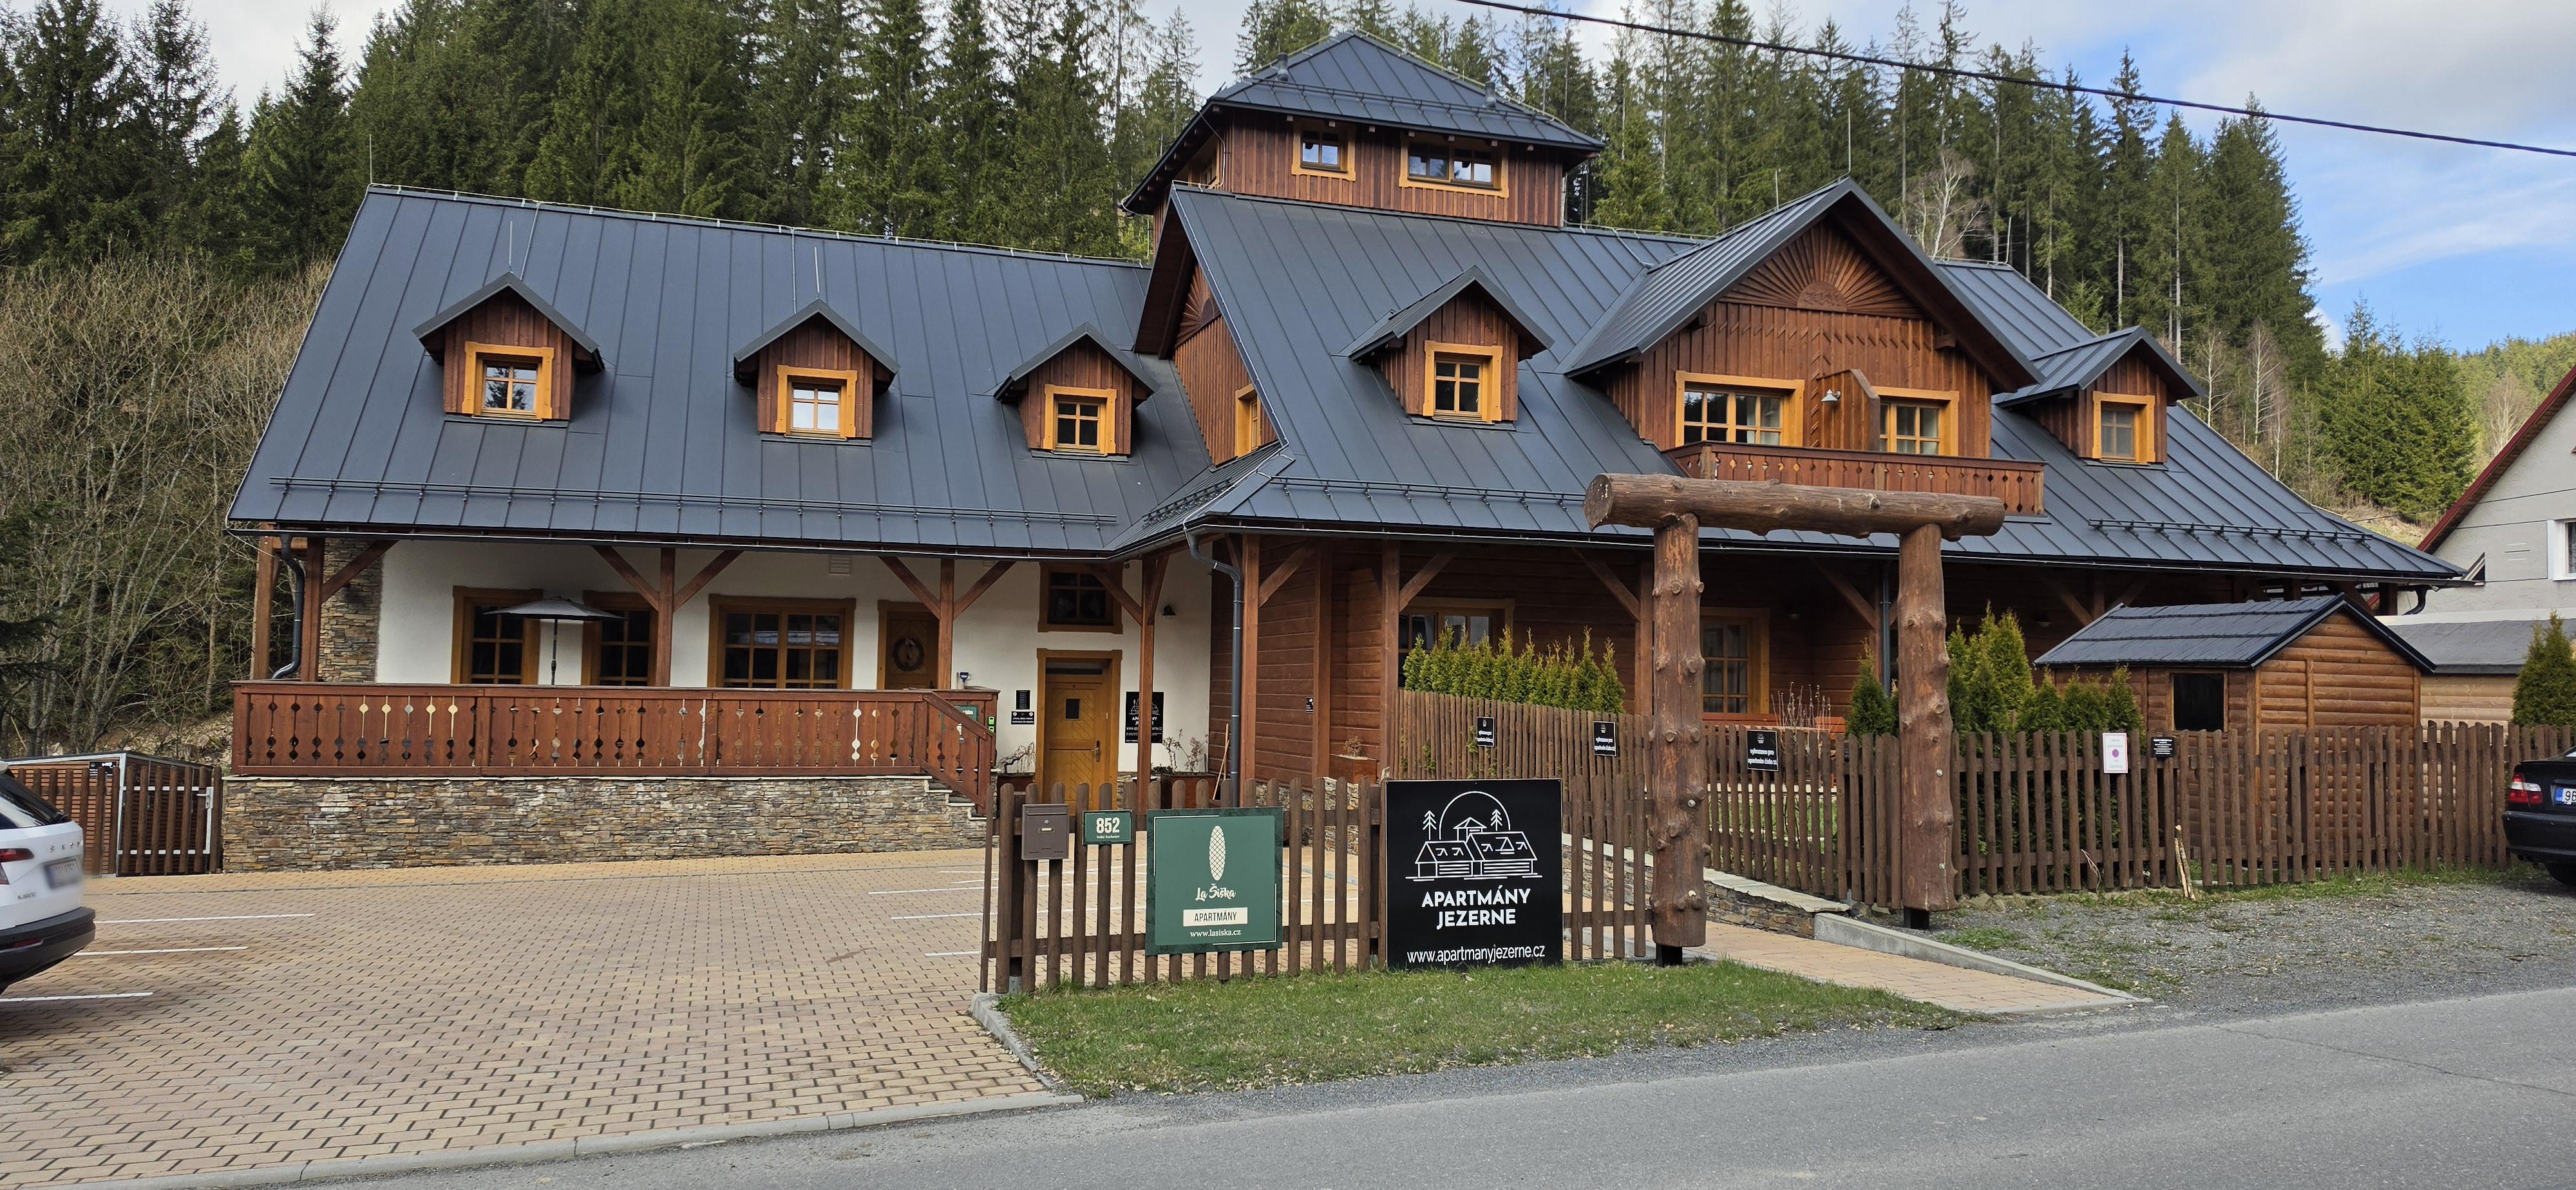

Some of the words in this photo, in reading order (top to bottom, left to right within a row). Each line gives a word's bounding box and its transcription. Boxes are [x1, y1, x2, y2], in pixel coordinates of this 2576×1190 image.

[1096, 817, 1120, 834] 852
[1195, 887, 1208, 902] La
[1209, 883, 1236, 900] Šiška
[1421, 885, 1531, 907] APARTMÁNY
[1195, 911, 1237, 922] APARTMÁNY
[1436, 909, 1516, 930] JEZERNE
[1190, 929, 1241, 937] www.lasiska.cz
[1406, 944, 1546, 965] www.apartmanyjezerne.cz
